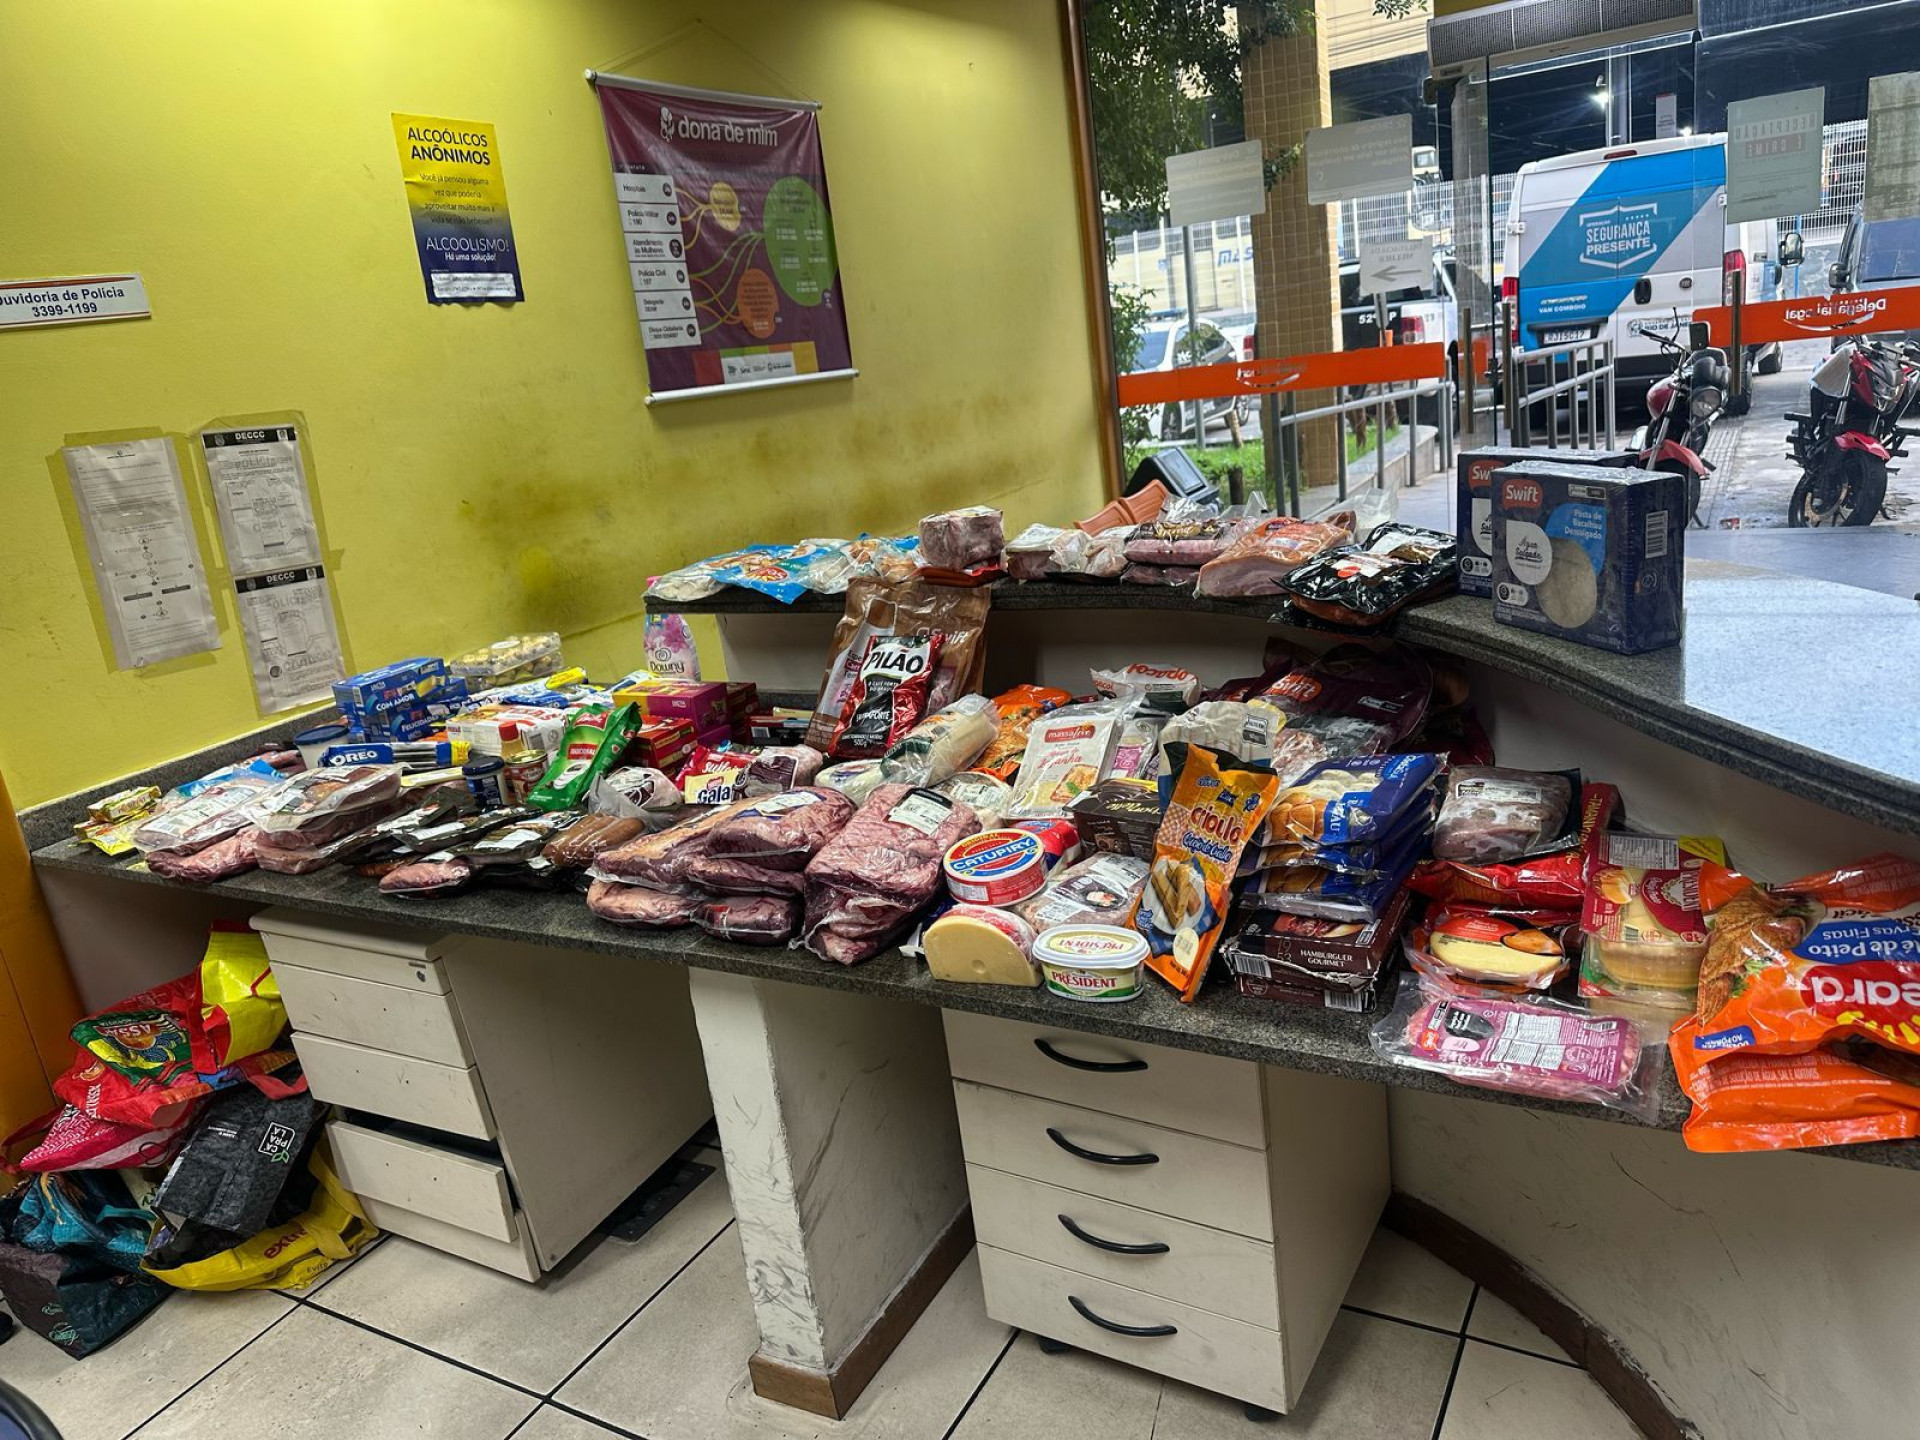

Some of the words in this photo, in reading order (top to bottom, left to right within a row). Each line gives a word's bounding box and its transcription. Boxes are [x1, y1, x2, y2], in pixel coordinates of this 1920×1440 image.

[407, 127, 488, 148] ALCOÓLICOS
[678, 114, 721, 140] dona
[724, 120, 744, 144] de
[747, 124, 778, 147] mim
[411, 144, 491, 166] ANÔNIMOS
[420, 172, 437, 182] Você
[1586, 220, 1651, 244] SEGURANÇA
[426, 237, 510, 252] ALCOOLISMO!
[1586, 236, 1651, 256] PRESENTE
[445, 252, 454, 261] Há
[471, 253, 497, 262] solução!
[62, 289, 79, 301] de
[32, 302, 98, 318] 3399-1199
[1554, 303, 1586, 312] COMBOIO
[235, 431, 265, 440] DECCC
[1506, 484, 1539, 503] Swift
[1592, 510, 1602, 520] de
[266, 571, 295, 582] DECCC
[931, 626, 969, 644] Sift
[650, 659, 685, 674] Downy
[863, 649, 924, 674] PILÃO
[376, 699, 393, 711] COM
[330, 750, 378, 766] OREO
[697, 786, 732, 804] Gala
[953, 838, 1032, 870] CATUPIRY
[1822, 926, 1870, 942] Finas
[1300, 949, 1353, 962] HAMBURGUER
[1807, 940, 1866, 958] Peito
[1869, 939, 1897, 957] de
[1307, 956, 1346, 967] GOURMET
[1051, 971, 1118, 988] PRÉSIDENT
[1811, 975, 1920, 1006] eara
[264, 1225, 308, 1259] extr
